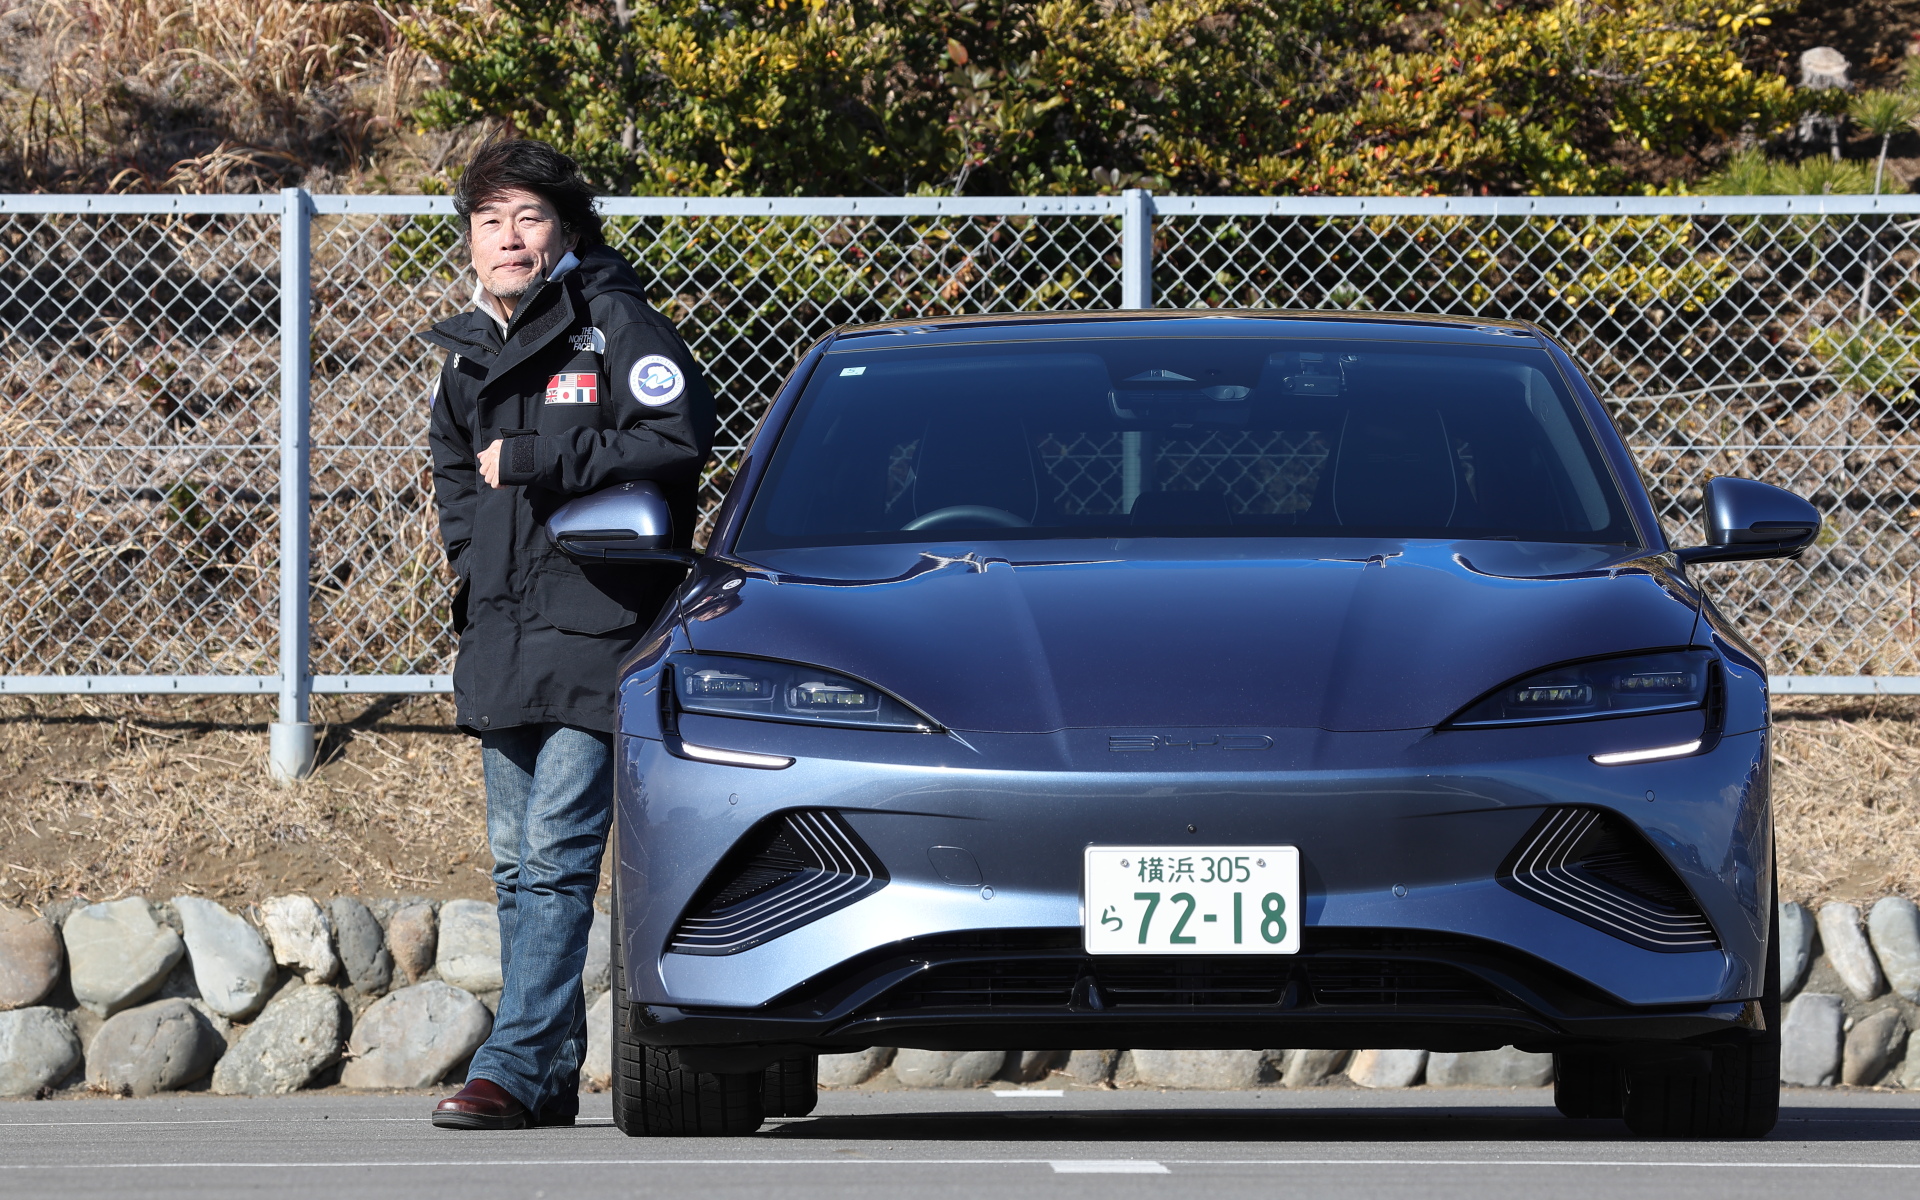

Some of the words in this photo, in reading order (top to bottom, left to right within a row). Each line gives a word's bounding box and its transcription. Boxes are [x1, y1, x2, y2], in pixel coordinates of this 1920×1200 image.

[582, 326, 593, 335] THE
[568, 334, 592, 343] NORTH
[573, 343, 592, 351] FACE
[1109, 734, 1274, 752] BYD
[1101, 905, 1123, 932] ら
[1134, 892, 1287, 944] 72-18
